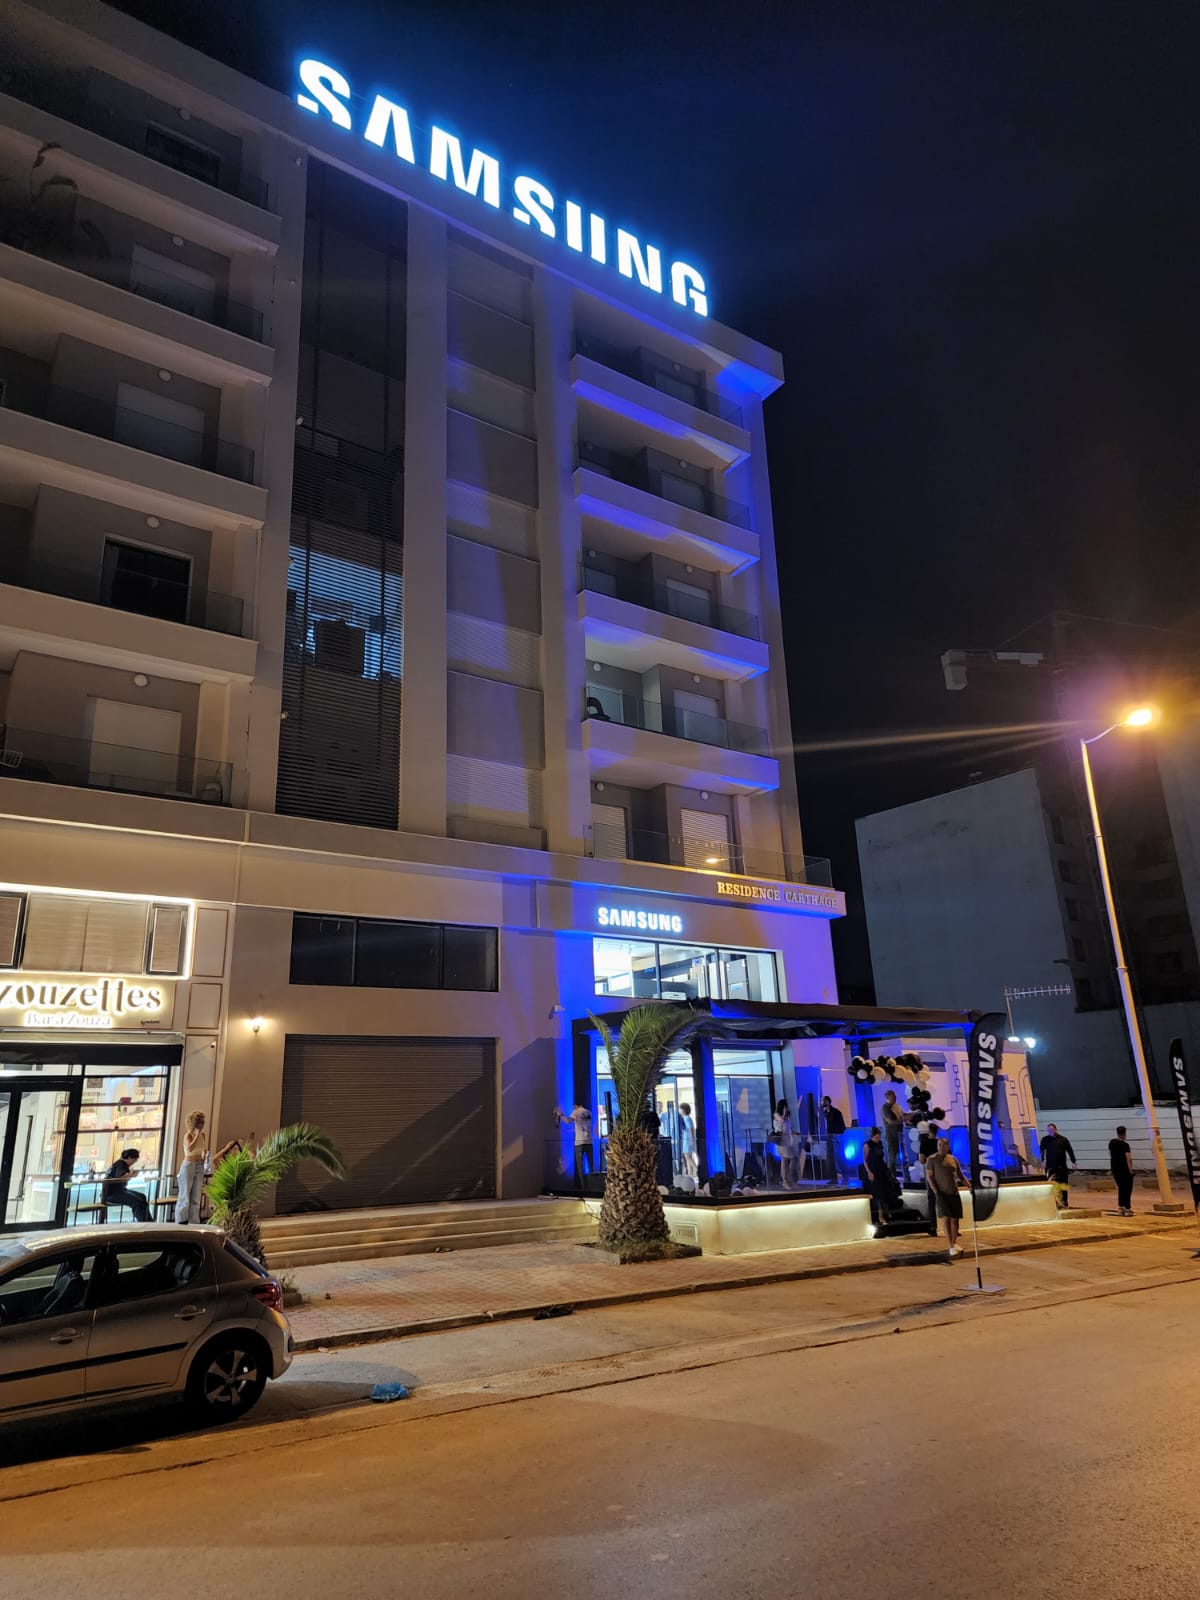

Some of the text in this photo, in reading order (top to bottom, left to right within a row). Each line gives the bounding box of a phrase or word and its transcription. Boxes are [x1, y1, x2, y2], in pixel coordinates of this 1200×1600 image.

[297, 58, 708, 317] SAMSUNG
[598, 907, 682, 933] SAMSUNG
[717, 882, 839, 909] RESIDENCE CARTHAGE
[977, 1032, 998, 1188] SAMSUNG
